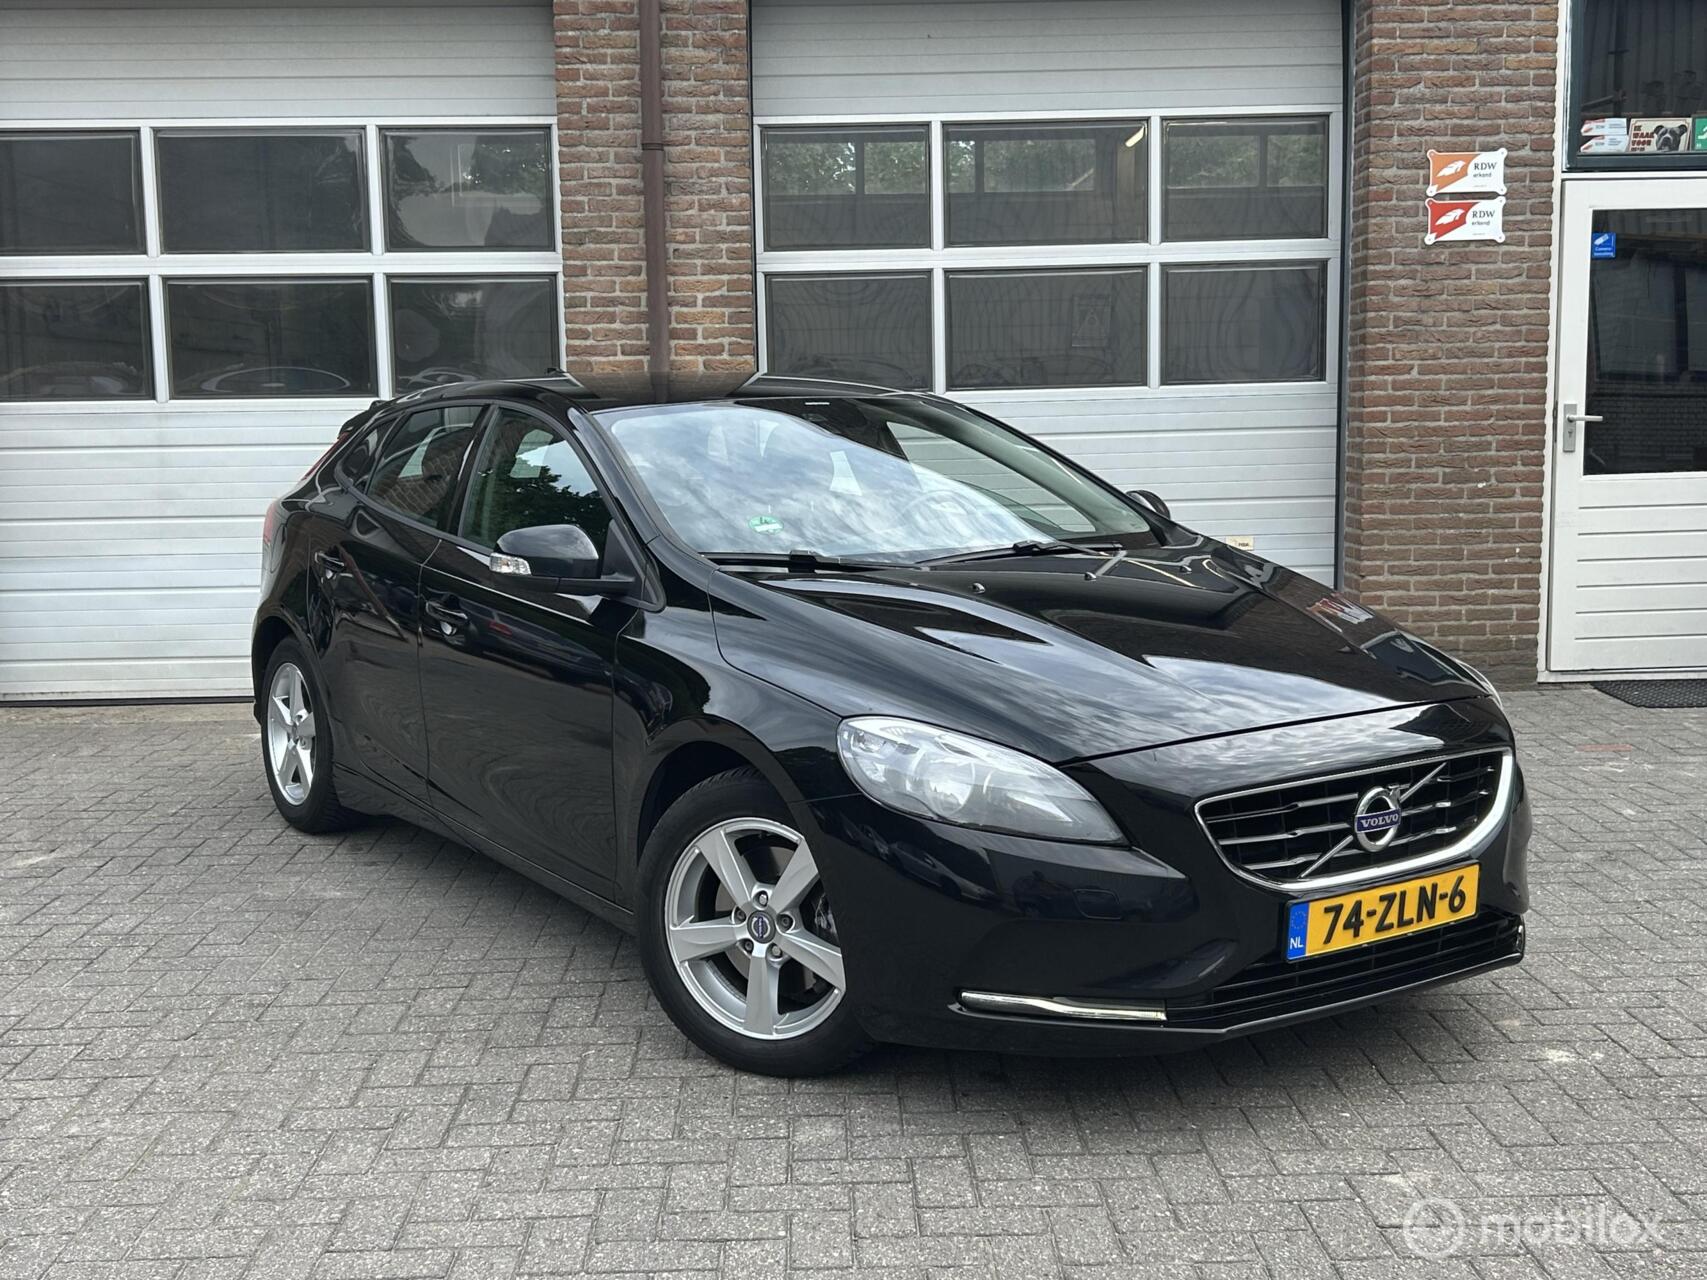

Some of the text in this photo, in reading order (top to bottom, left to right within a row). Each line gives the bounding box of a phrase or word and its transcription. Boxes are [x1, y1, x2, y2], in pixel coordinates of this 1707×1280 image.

[1474, 162, 1497, 170] RDW
[1472, 210, 1495, 218] RDW
[1360, 813, 1399, 828] VOLVO
[1323, 875, 1466, 944] 74-ZLN-6
[1289, 937, 1304, 949] NL
